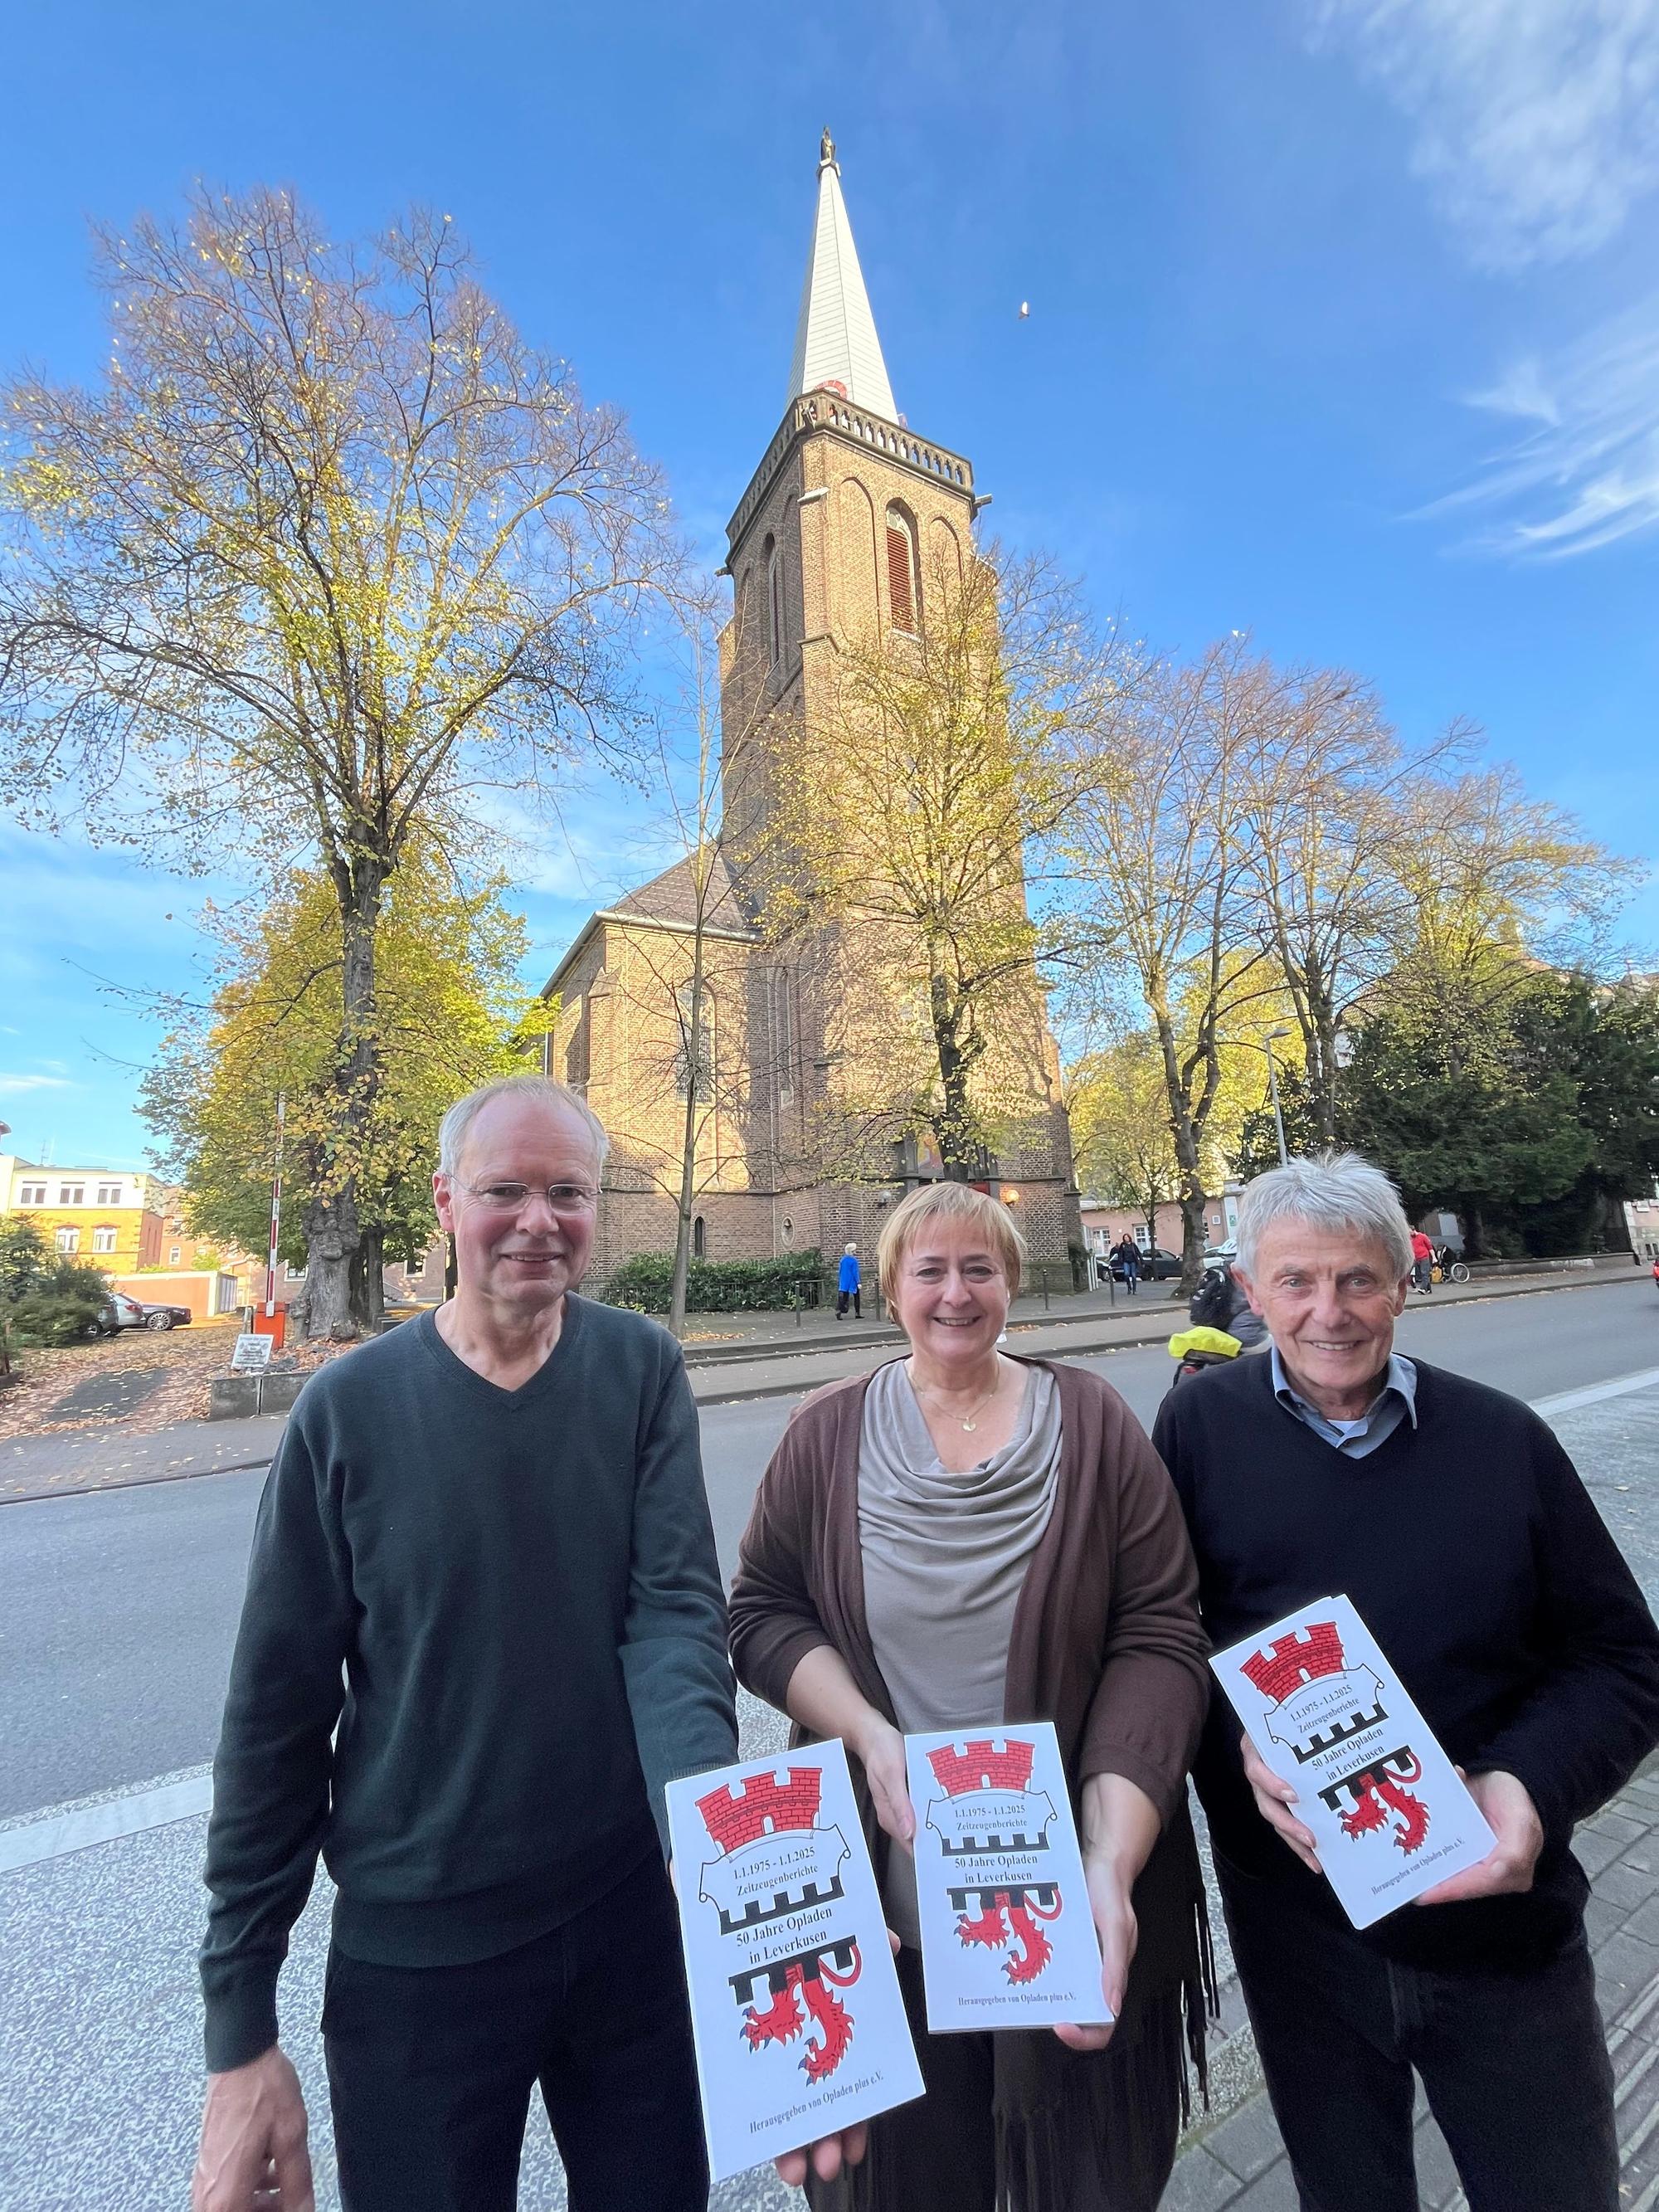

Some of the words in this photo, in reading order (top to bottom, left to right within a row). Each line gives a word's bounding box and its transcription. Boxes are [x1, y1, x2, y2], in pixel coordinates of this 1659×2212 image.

[1290, 1701, 1319, 1722] 1.1.1975
[1322, 1684, 1353, 1704] 1.1.2025
[1297, 1698, 1360, 1733] Zeitzeugenberichte
[1311, 1759, 1323, 1771] 50
[1324, 1746, 1347, 1764] Jahre
[1346, 1728, 1384, 1751] Opladen
[1326, 1771, 1337, 1781] in
[1335, 1746, 1385, 1776] Leverkusen
[955, 1807, 986, 1818] 1.1.1975
[994, 1805, 1026, 1815] 1.1.2025
[956, 1819, 1028, 1830] Zeitzeugenberichte
[733, 1859, 771, 1879] 1.1.1975
[779, 1846, 815, 1866] 1.1.2025
[955, 1858, 966, 1869] 50
[968, 1857, 995, 1868] Jahre
[997, 1854, 1038, 1868] Opladen
[1419, 1850, 1443, 1866] Opladen
[736, 1864, 819, 1897] Zeitzeugenberichte
[965, 1873, 974, 1883] in
[977, 1871, 1033, 1883] Leverkusen
[736, 1931, 750, 1947] 50
[752, 1922, 784, 1942] Jahre
[786, 1907, 833, 1931] Opladen
[748, 1951, 761, 1965] in
[763, 1931, 828, 1960] Leverkusen
[958, 1995, 1006, 2006] Herausgegeben
[1020, 1993, 1048, 2005] Opladen
[1049, 1993, 1063, 2004] plus
[1063, 1991, 1077, 2001] e.V.
[749, 2103, 807, 2134] Herausgegeben
[808, 2098, 822, 2109] von
[823, 2084, 854, 2103] Opladen
[854, 2078, 869, 2093] plus
[870, 2070, 884, 2085] e.V.
